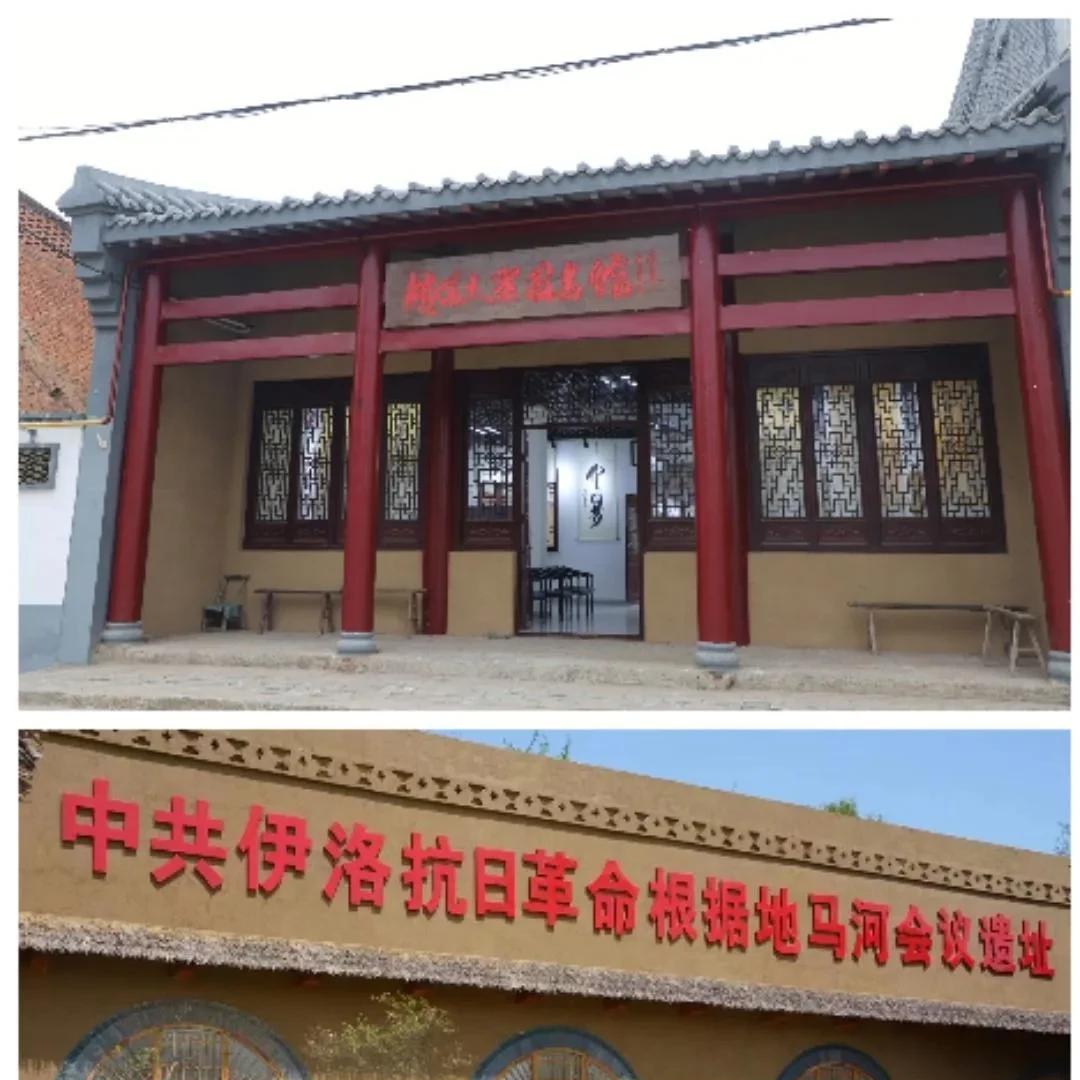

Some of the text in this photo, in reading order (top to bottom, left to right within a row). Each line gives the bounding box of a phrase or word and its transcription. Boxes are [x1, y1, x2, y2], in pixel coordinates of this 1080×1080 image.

[60, 778, 1056, 980] 中共伊洛抗日革命根据地马河会议遗址
